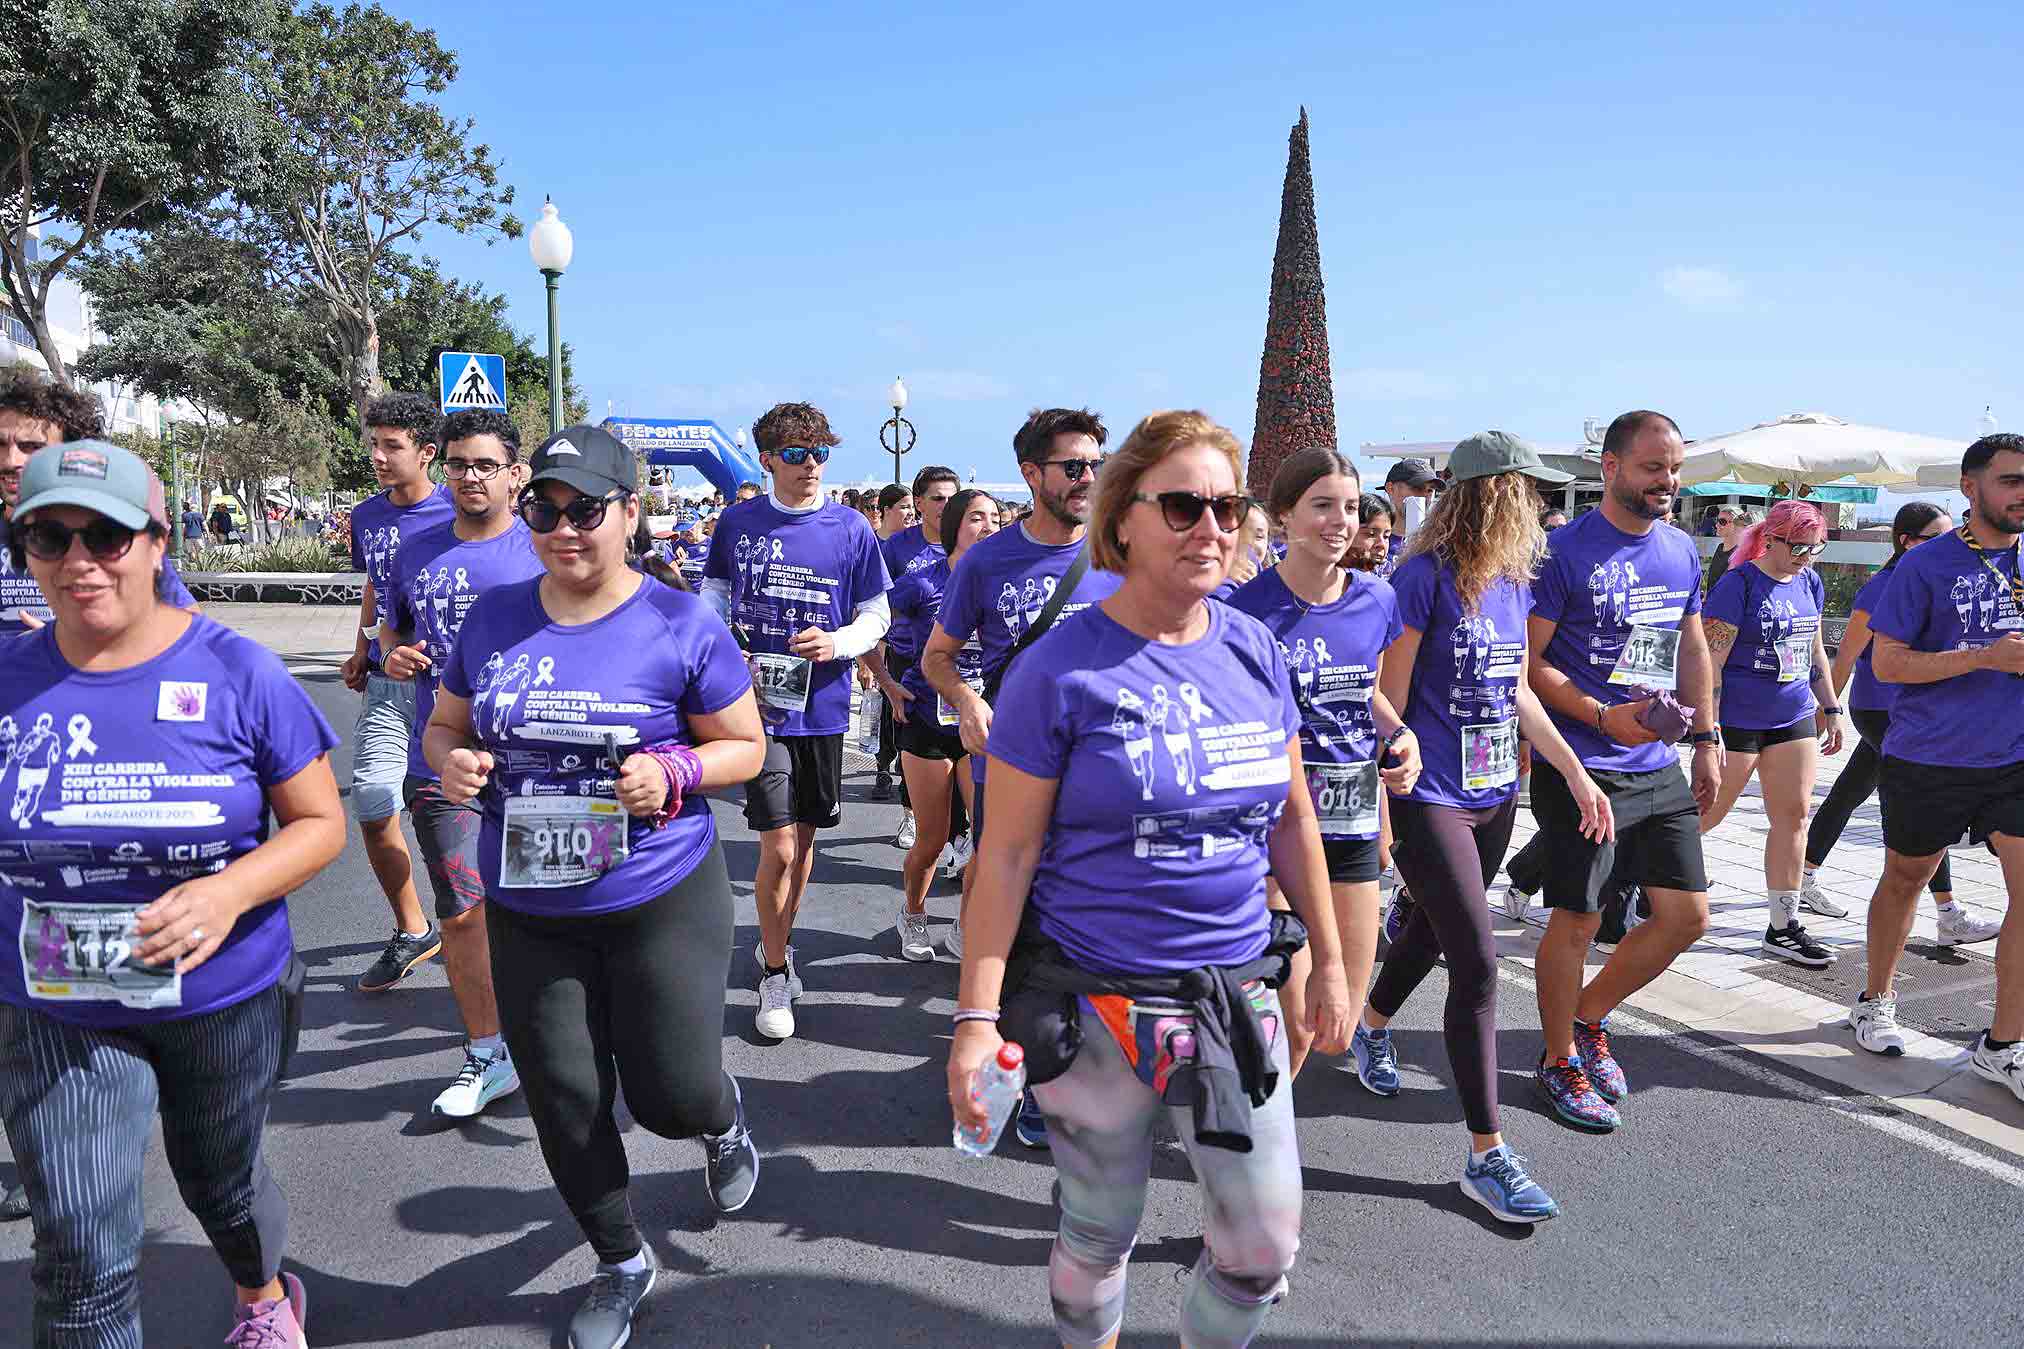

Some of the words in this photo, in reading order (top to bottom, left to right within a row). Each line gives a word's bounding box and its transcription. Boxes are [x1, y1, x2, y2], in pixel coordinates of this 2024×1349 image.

[768, 570, 796, 579] CONTRA
[782, 565, 814, 575] CARRERA
[1, 588, 36, 597] CONTRA
[1623, 643, 1657, 667] 016
[1332, 664, 1368, 675] CARRERA
[1319, 674, 1350, 684] CONTRA
[1350, 673, 1361, 681] LA
[549, 690, 601, 701] CARRERA
[525, 700, 570, 711] CONTRA
[571, 701, 588, 711] LA
[588, 702, 652, 713] VIOLENCIA
[523, 710, 540, 720] DE
[540, 709, 587, 722] GÉNERO
[540, 727, 594, 739] LANZAROTE
[93, 762, 168, 775] CARRERA
[61, 776, 129, 789] CONTRA
[129, 776, 151, 788] LA
[153, 775, 235, 787] VIOLENCIA
[61, 790, 84, 802] DE
[85, 788, 152, 802] GÉNERO
[1317, 786, 1362, 813] 016
[85, 809, 165, 820] LANZAROTE
[167, 844, 197, 861] ICI
